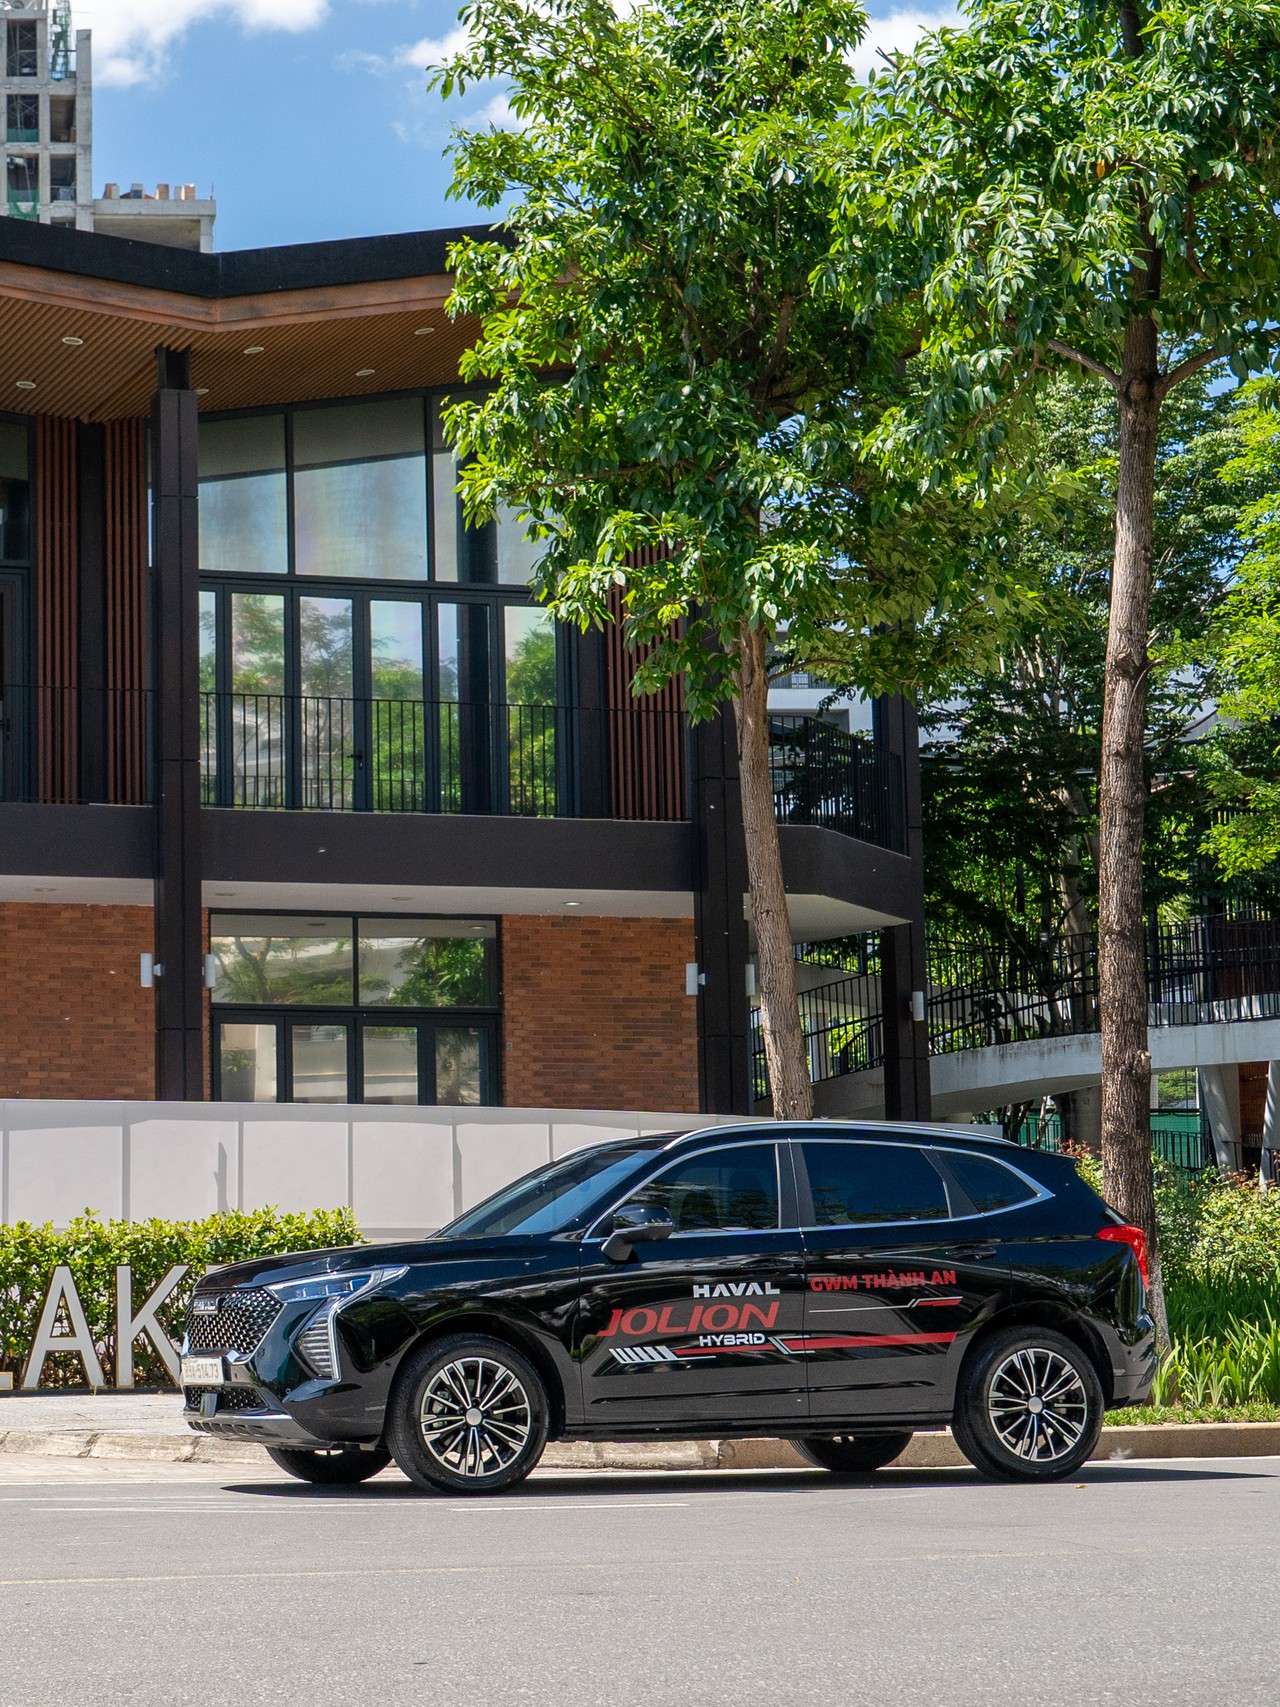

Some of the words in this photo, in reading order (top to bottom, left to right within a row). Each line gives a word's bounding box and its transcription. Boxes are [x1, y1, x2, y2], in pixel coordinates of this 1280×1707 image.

[693, 1281, 781, 1298] HAVAL
[810, 1276, 858, 1292] GWM
[861, 1269, 926, 1289] THÀNH
[928, 1270, 957, 1286] AN
[596, 1301, 780, 1337] JOLION
[698, 1333, 766, 1347] HYBRID
